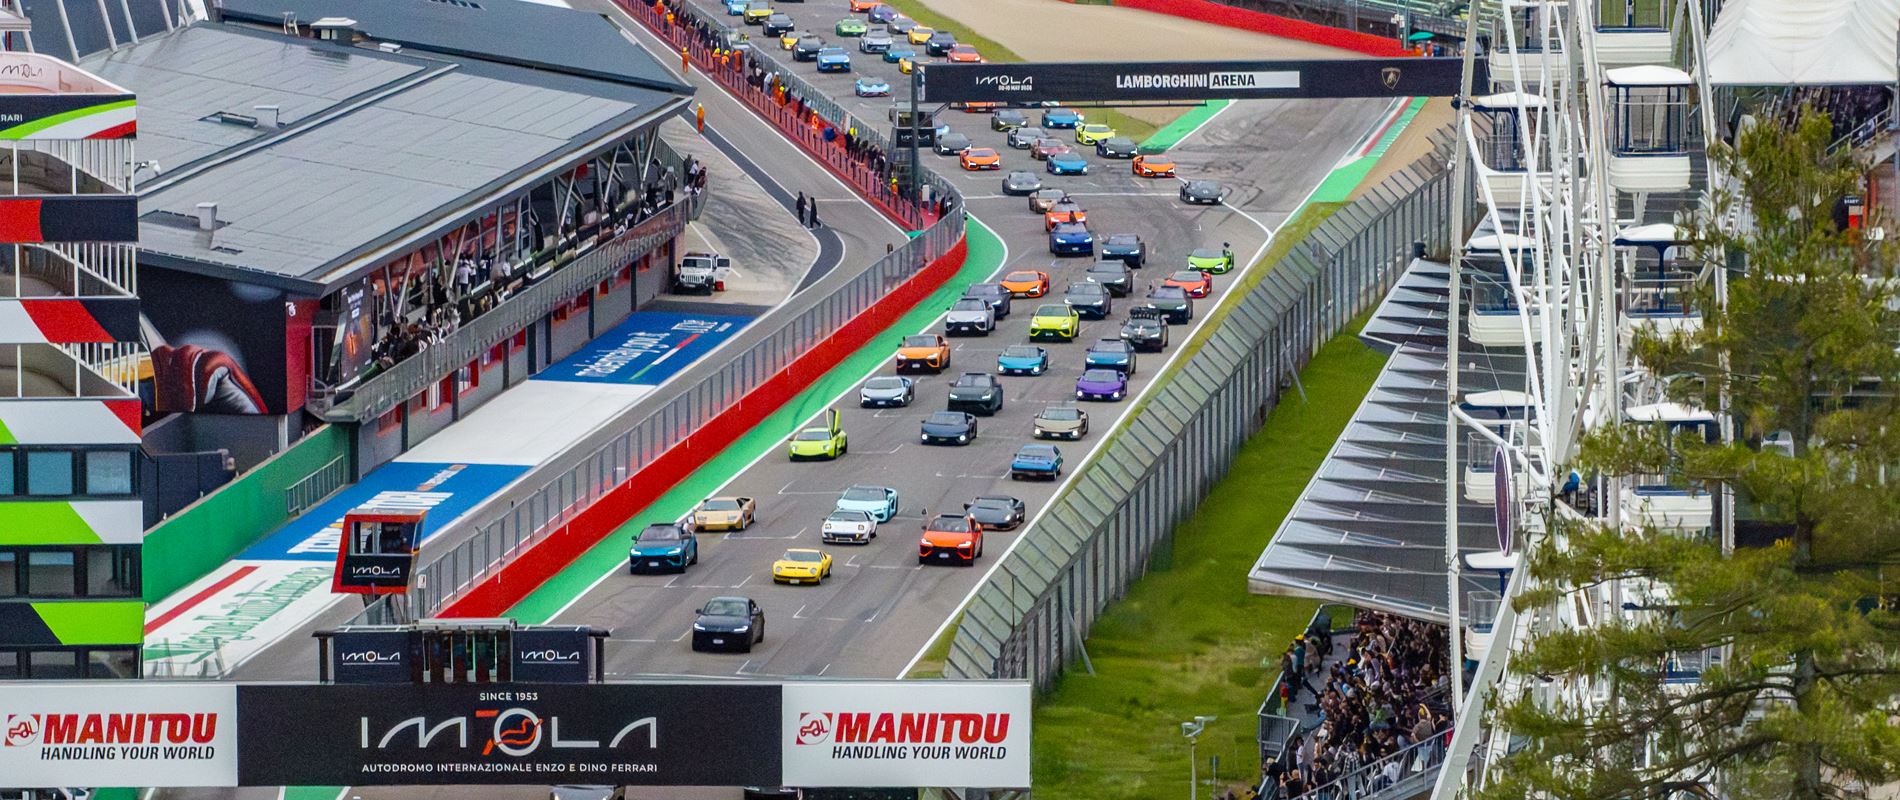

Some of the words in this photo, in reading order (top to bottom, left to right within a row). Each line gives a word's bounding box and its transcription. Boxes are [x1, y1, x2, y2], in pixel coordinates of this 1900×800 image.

[975, 75, 1033, 86] IMOLA
[1116, 74, 1208, 89] LAMBORGHINI
[1212, 73, 1256, 87] ARENA
[352, 565, 401, 576] IMOLA
[341, 650, 400, 662] IMOLA
[521, 649, 580, 661] IMOLA
[479, 691, 512, 701] SINCE
[515, 691, 538, 701] 1953
[43, 713, 218, 744] MANITOU
[834, 712, 1010, 743] MANITOU
[40, 746, 116, 760] HANDLING
[121, 746, 159, 760] YOUR
[163, 746, 215, 760] WORLD
[832, 745, 907, 759] HANDLING
[912, 745, 951, 759] YOUR
[955, 746, 1007, 759] WORLD
[361, 763, 434, 773] AUTODROMO
[437, 763, 532, 773] INTERNAZIONALE
[535, 763, 566, 773] ENZO
[569, 763, 576, 772] E
[579, 763, 608, 773] DINO
[611, 763, 658, 773] FERRARI
